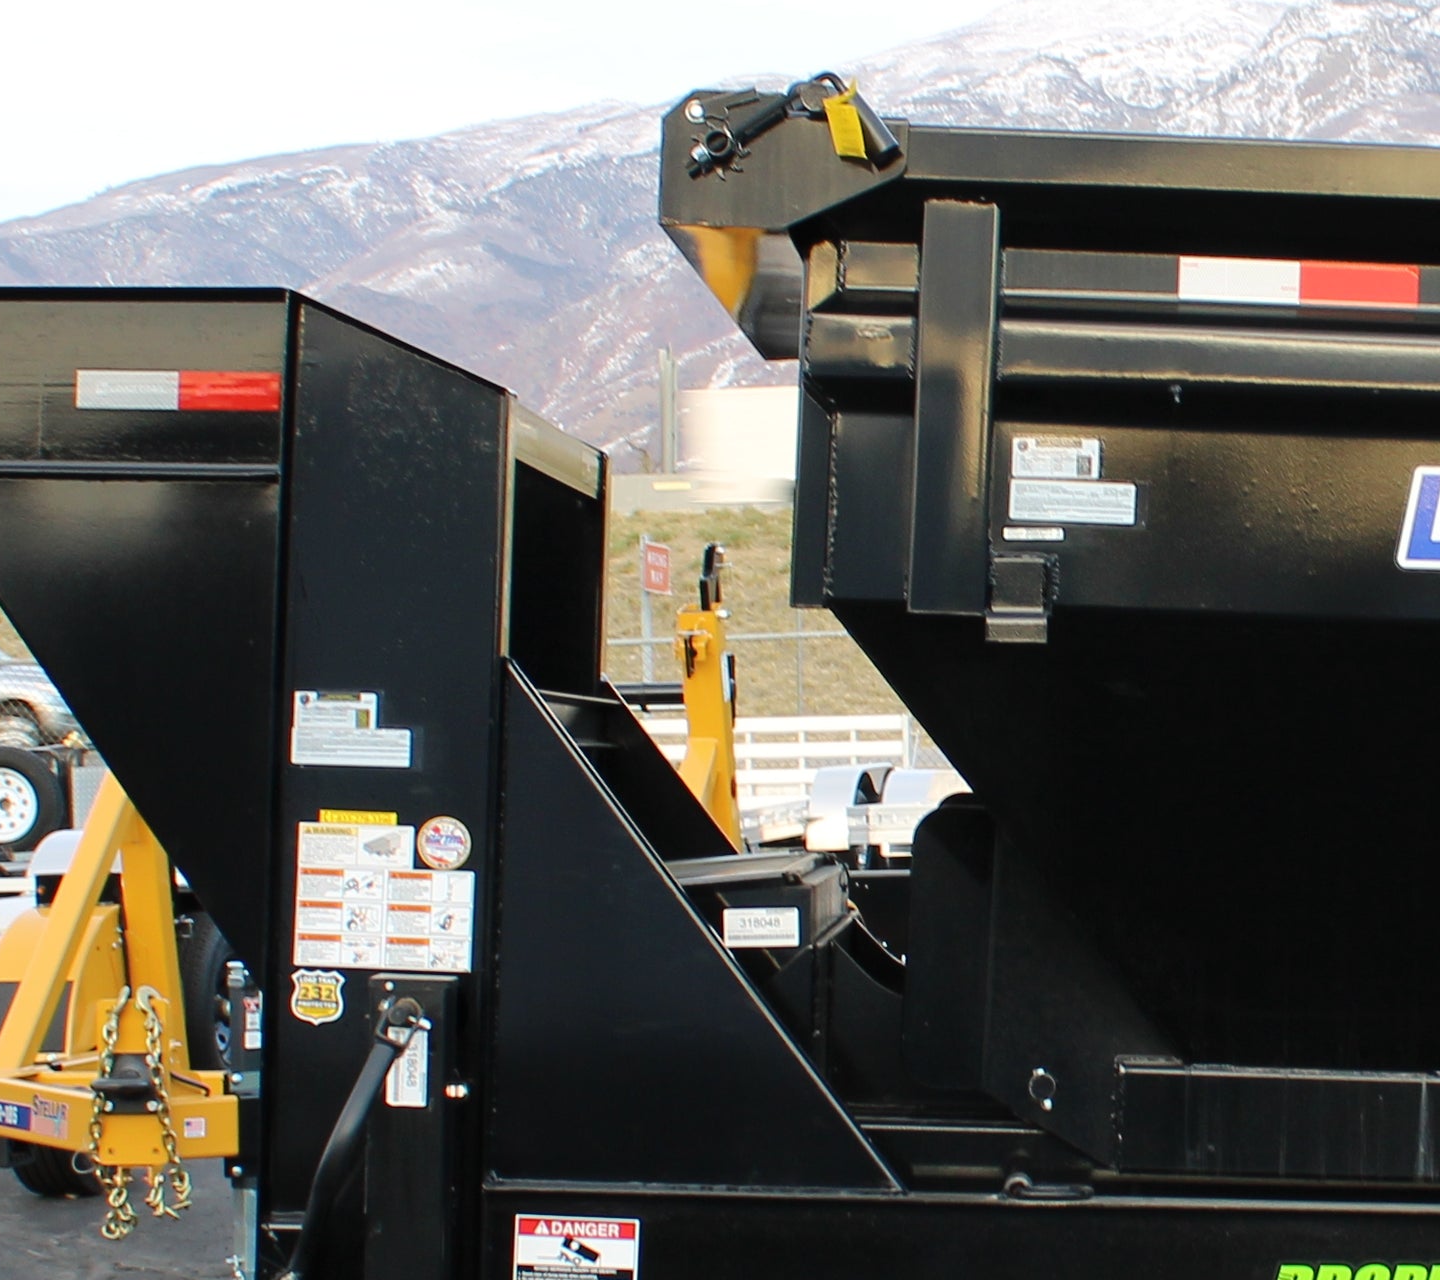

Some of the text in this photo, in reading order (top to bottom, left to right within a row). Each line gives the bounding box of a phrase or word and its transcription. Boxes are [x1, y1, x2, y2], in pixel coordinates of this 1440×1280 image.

[740, 917, 780, 928] 318048
[300, 986, 334, 1000] 232
[551, 1220, 620, 1238] DANGER
